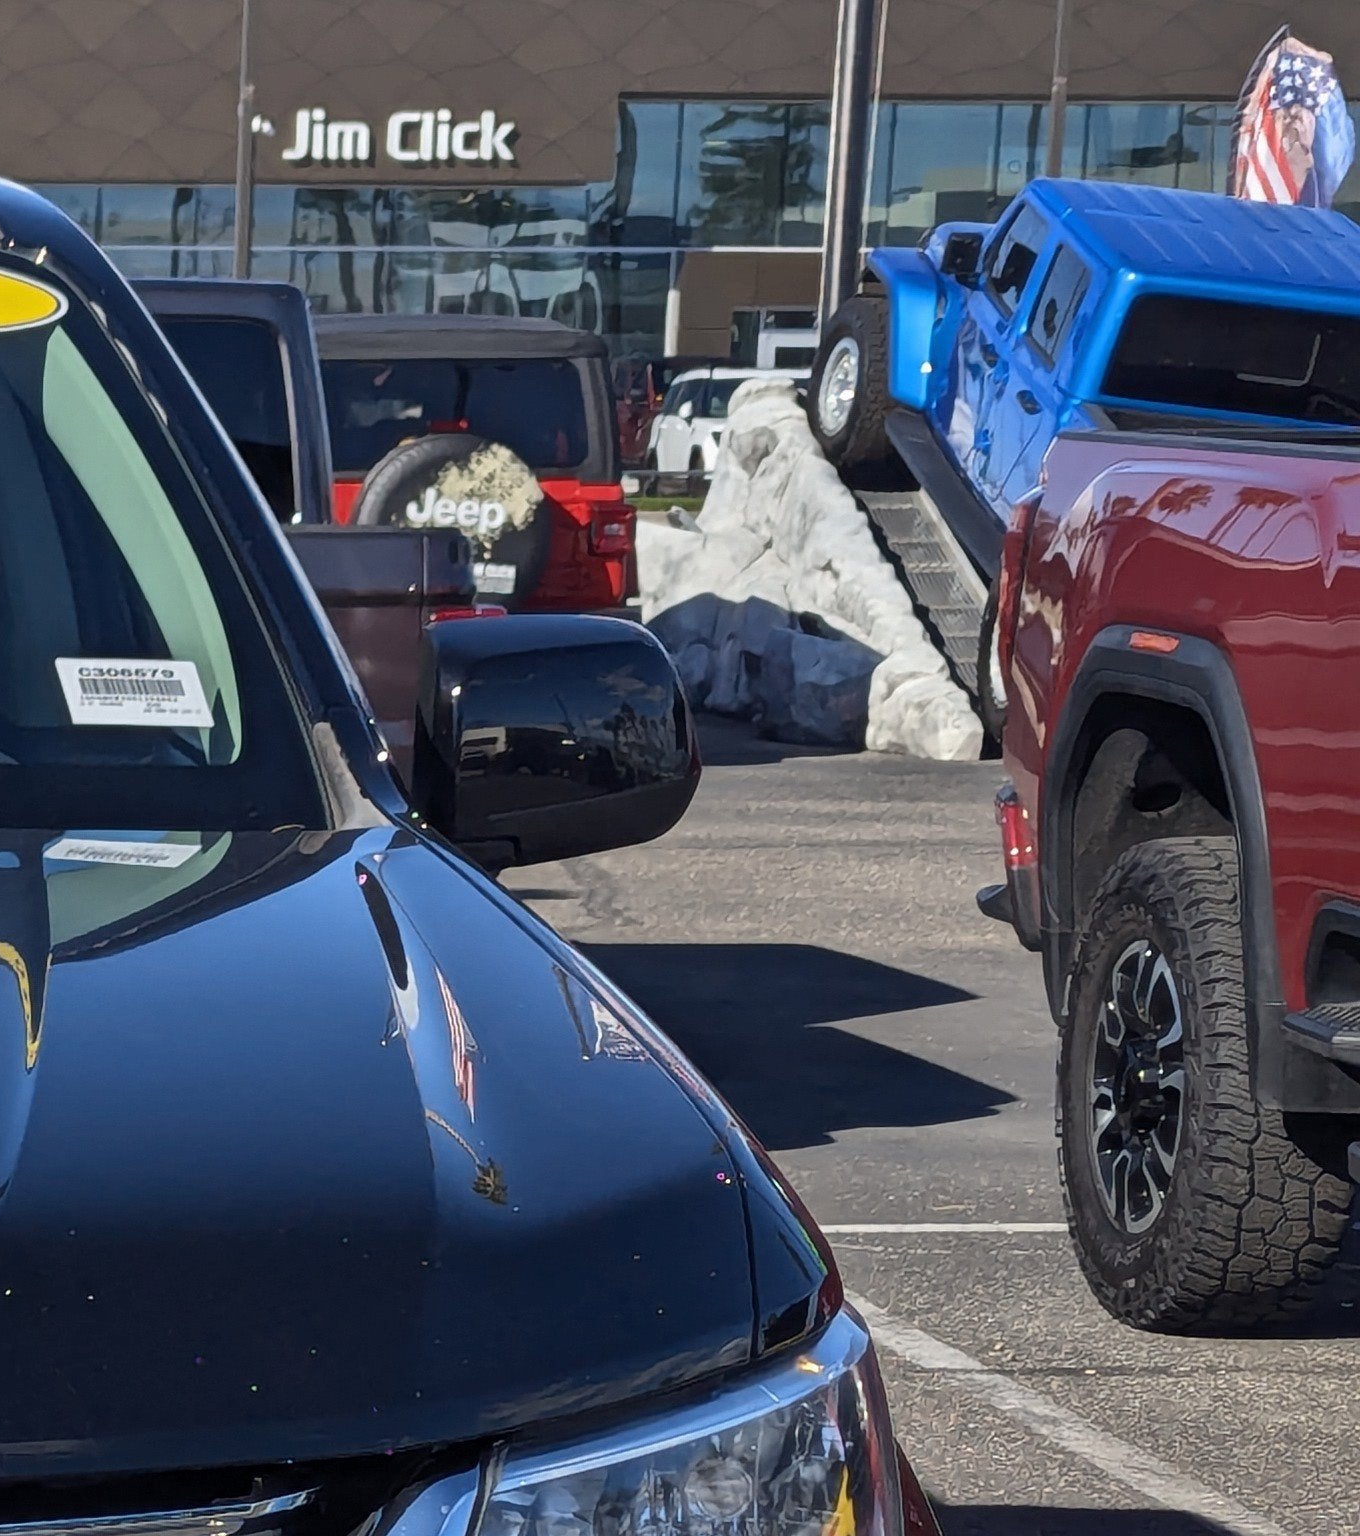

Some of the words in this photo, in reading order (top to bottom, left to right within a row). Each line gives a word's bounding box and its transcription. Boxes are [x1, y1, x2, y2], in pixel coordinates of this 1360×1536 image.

[282, 108, 371, 161] Jim
[386, 108, 516, 161] Click
[406, 486, 506, 534] Jeep
